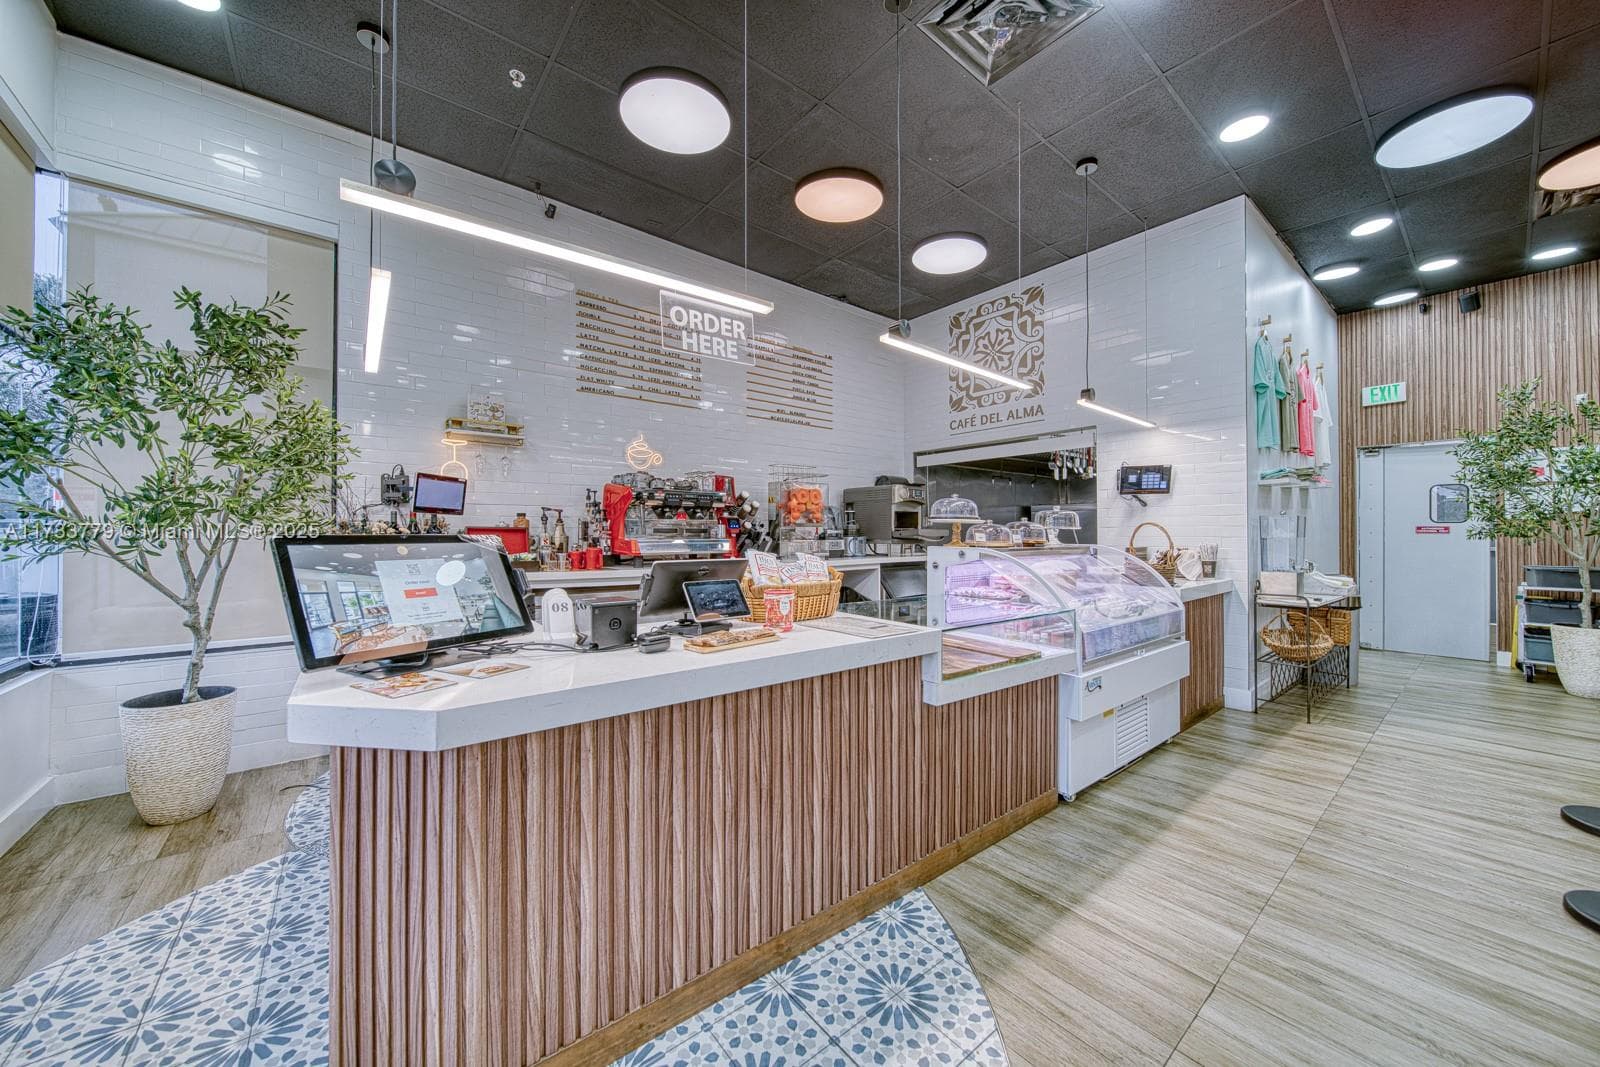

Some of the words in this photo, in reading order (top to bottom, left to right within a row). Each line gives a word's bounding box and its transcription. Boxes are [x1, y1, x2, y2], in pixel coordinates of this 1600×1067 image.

[578, 299, 606, 312] ESPRESSO
[579, 321, 615, 334] MACCHIATO
[670, 305, 746, 341] ORDER
[579, 331, 599, 341] LATTE
[579, 342, 605, 352] MATCHA
[609, 348, 628, 357] LATTE
[682, 330, 739, 360] HERE
[579, 352, 617, 365] CAPPUCCINO
[664, 350, 680, 358] LATTE
[579, 363, 617, 375] MOCACCINO
[596, 377, 615, 385] WHITE
[580, 385, 614, 395] AMERICANO
[1370, 383, 1400, 403] EXIT
[949, 413, 977, 431] CAFÉ
[980, 412, 1003, 426] DEL
[1006, 404, 1044, 421] ALMA
